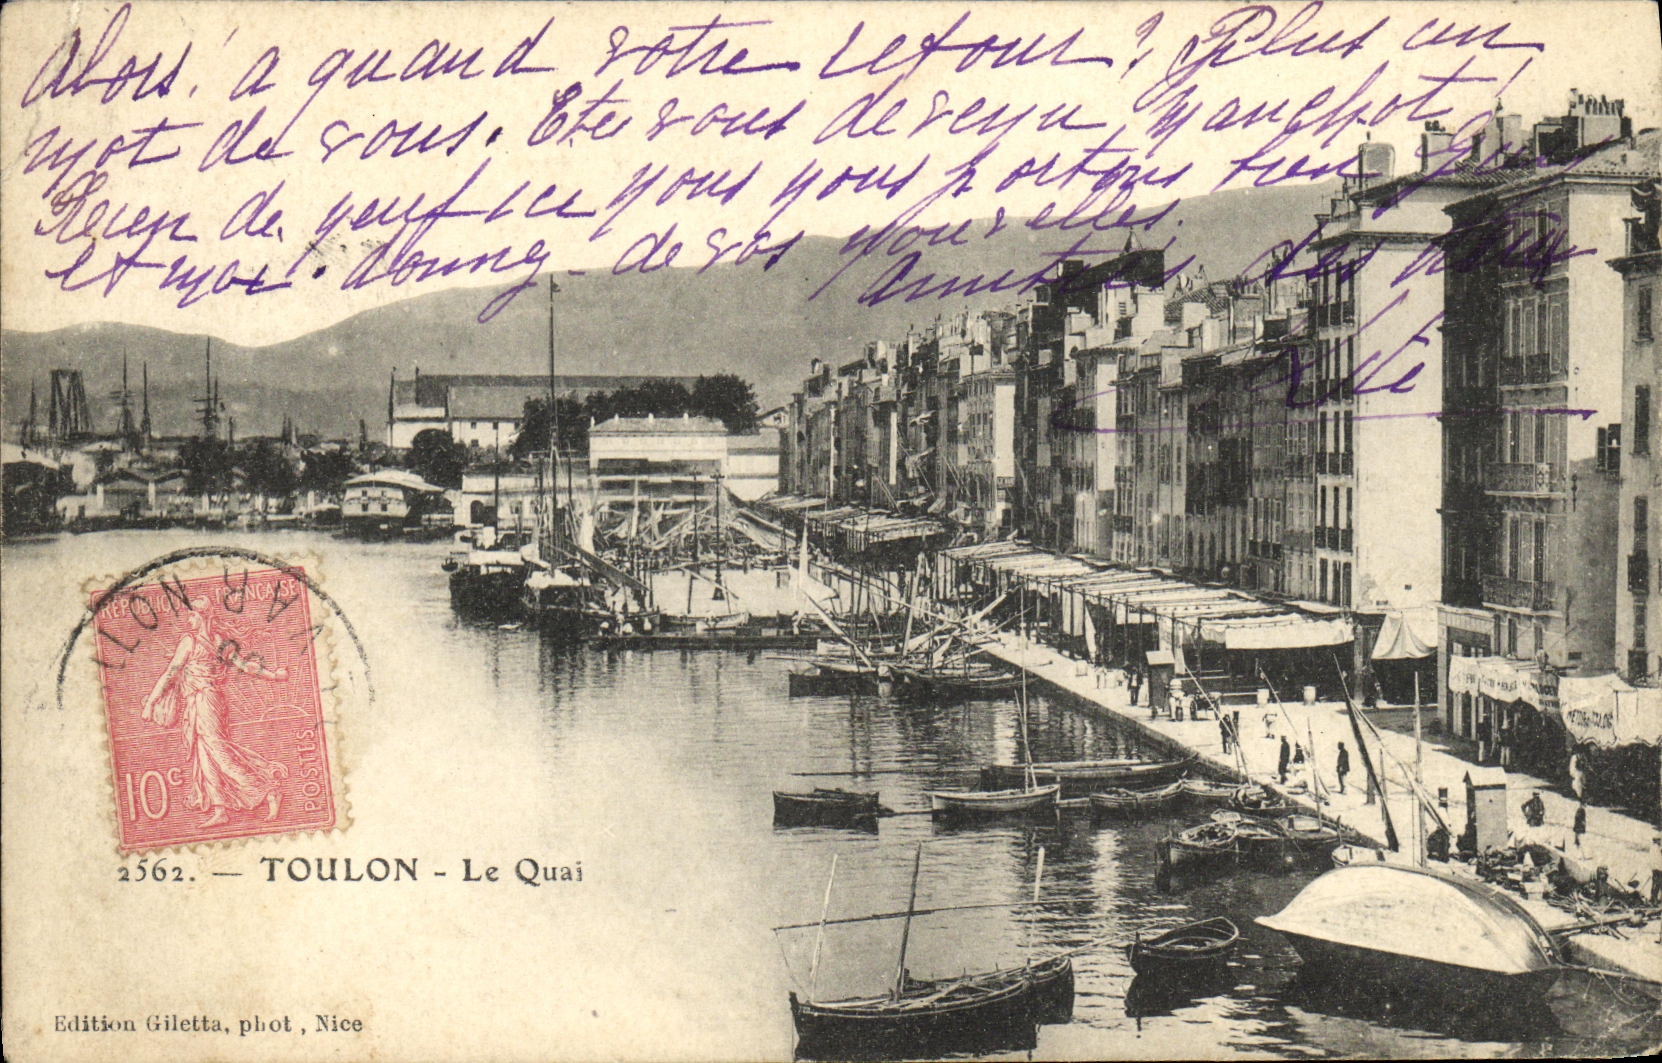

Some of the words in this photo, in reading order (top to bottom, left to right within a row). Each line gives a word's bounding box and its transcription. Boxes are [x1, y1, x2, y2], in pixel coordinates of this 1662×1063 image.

[276, 16, 556, 140] quand
[1133, 1, 1390, 111] Plus
[198, 106, 290, 172] de
[296, 728, 323, 813] POSTES
